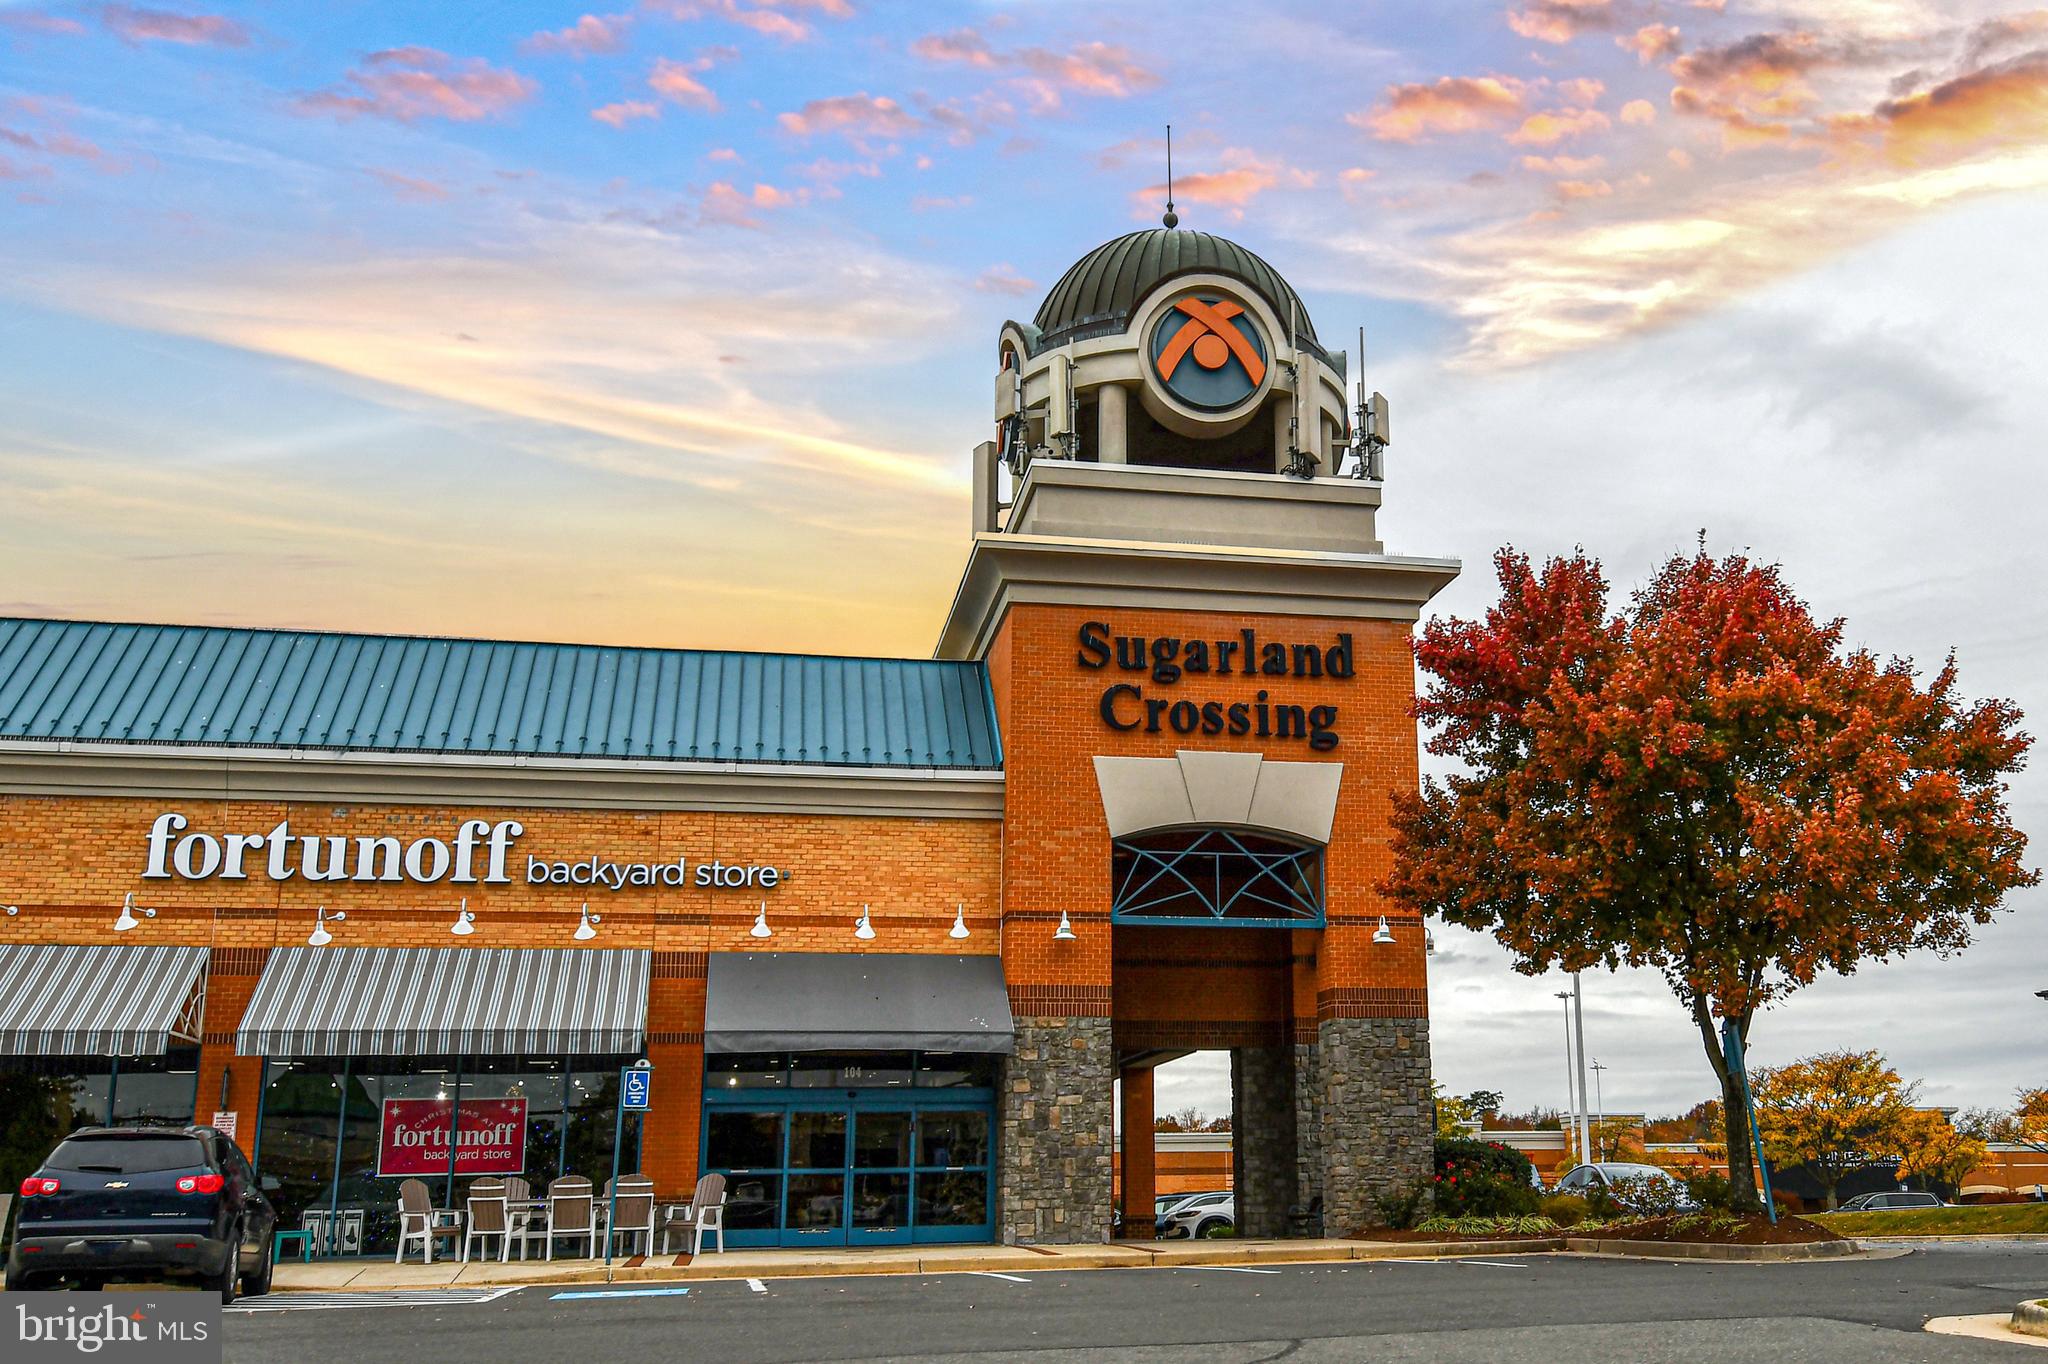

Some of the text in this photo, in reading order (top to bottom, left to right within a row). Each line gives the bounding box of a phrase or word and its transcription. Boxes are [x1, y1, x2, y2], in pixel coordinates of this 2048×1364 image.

[1078, 621, 1356, 684] Sugarland
[1101, 684, 1339, 750] Crossing
[141, 813, 524, 883] fortunoff
[527, 854, 778, 890] backyard store
[844, 1066, 862, 1078] 104
[392, 1122, 517, 1147] fortunoff
[423, 1149, 512, 1162] backyard store
